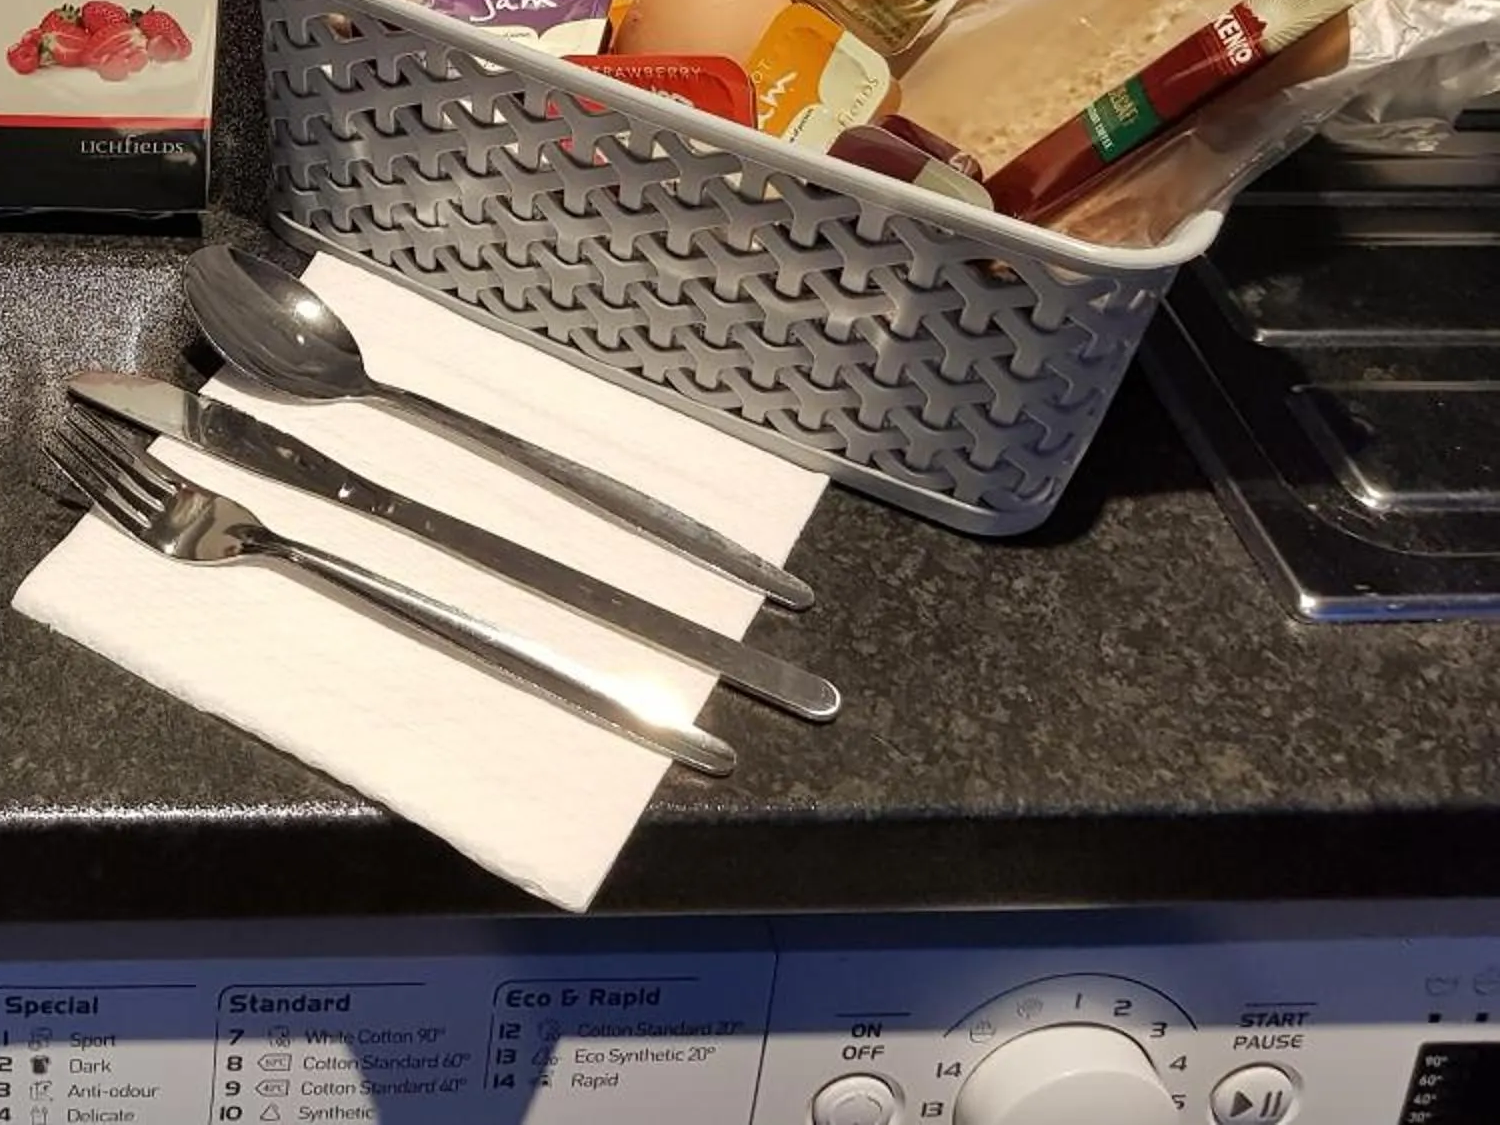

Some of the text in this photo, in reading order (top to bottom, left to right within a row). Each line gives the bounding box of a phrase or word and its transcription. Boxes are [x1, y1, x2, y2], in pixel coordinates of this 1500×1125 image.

[4, 996, 100, 1019] Special
[229, 994, 351, 1015] Standard
[505, 987, 661, 1011] Eco & Rapid
[1075, 993, 1083, 1010] 1
[1113, 1000, 1133, 1017] 2
[1239, 1012, 1312, 1028] START
[228, 1029, 245, 1046] 7
[304, 1028, 354, 1045] White
[357, 1028, 413, 1045] Cotton
[498, 1023, 522, 1040] 12
[851, 1023, 883, 1039] ON
[1150, 1022, 1169, 1038] 3
[2, 1029, 117, 1052] 1 Sport
[1232, 1034, 1306, 1051] PAUSE
[496, 1048, 518, 1066] 13
[574, 1048, 605, 1065] Eco
[607, 1046, 685, 1067] Synthetic
[841, 1044, 886, 1061] OFF
[69, 1059, 113, 1074] Dark
[226, 1055, 244, 1072] 8
[303, 1055, 360, 1072] Cotton
[360, 1054, 439, 1071] Standard
[934, 1062, 963, 1079] 14
[1169, 1055, 1189, 1072] 4
[225, 1080, 242, 1097] 9
[301, 1081, 357, 1098] Cotton
[358, 1079, 437, 1096] Standard
[493, 1073, 620, 1090] 14 Rapid
[67, 1083, 160, 1099] Anti-odour
[920, 1101, 946, 1119] 13
[1171, 1094, 1188, 1111] 5
[67, 1108, 137, 1124] Delicate
[219, 1105, 374, 1125] 10 Synthetic
